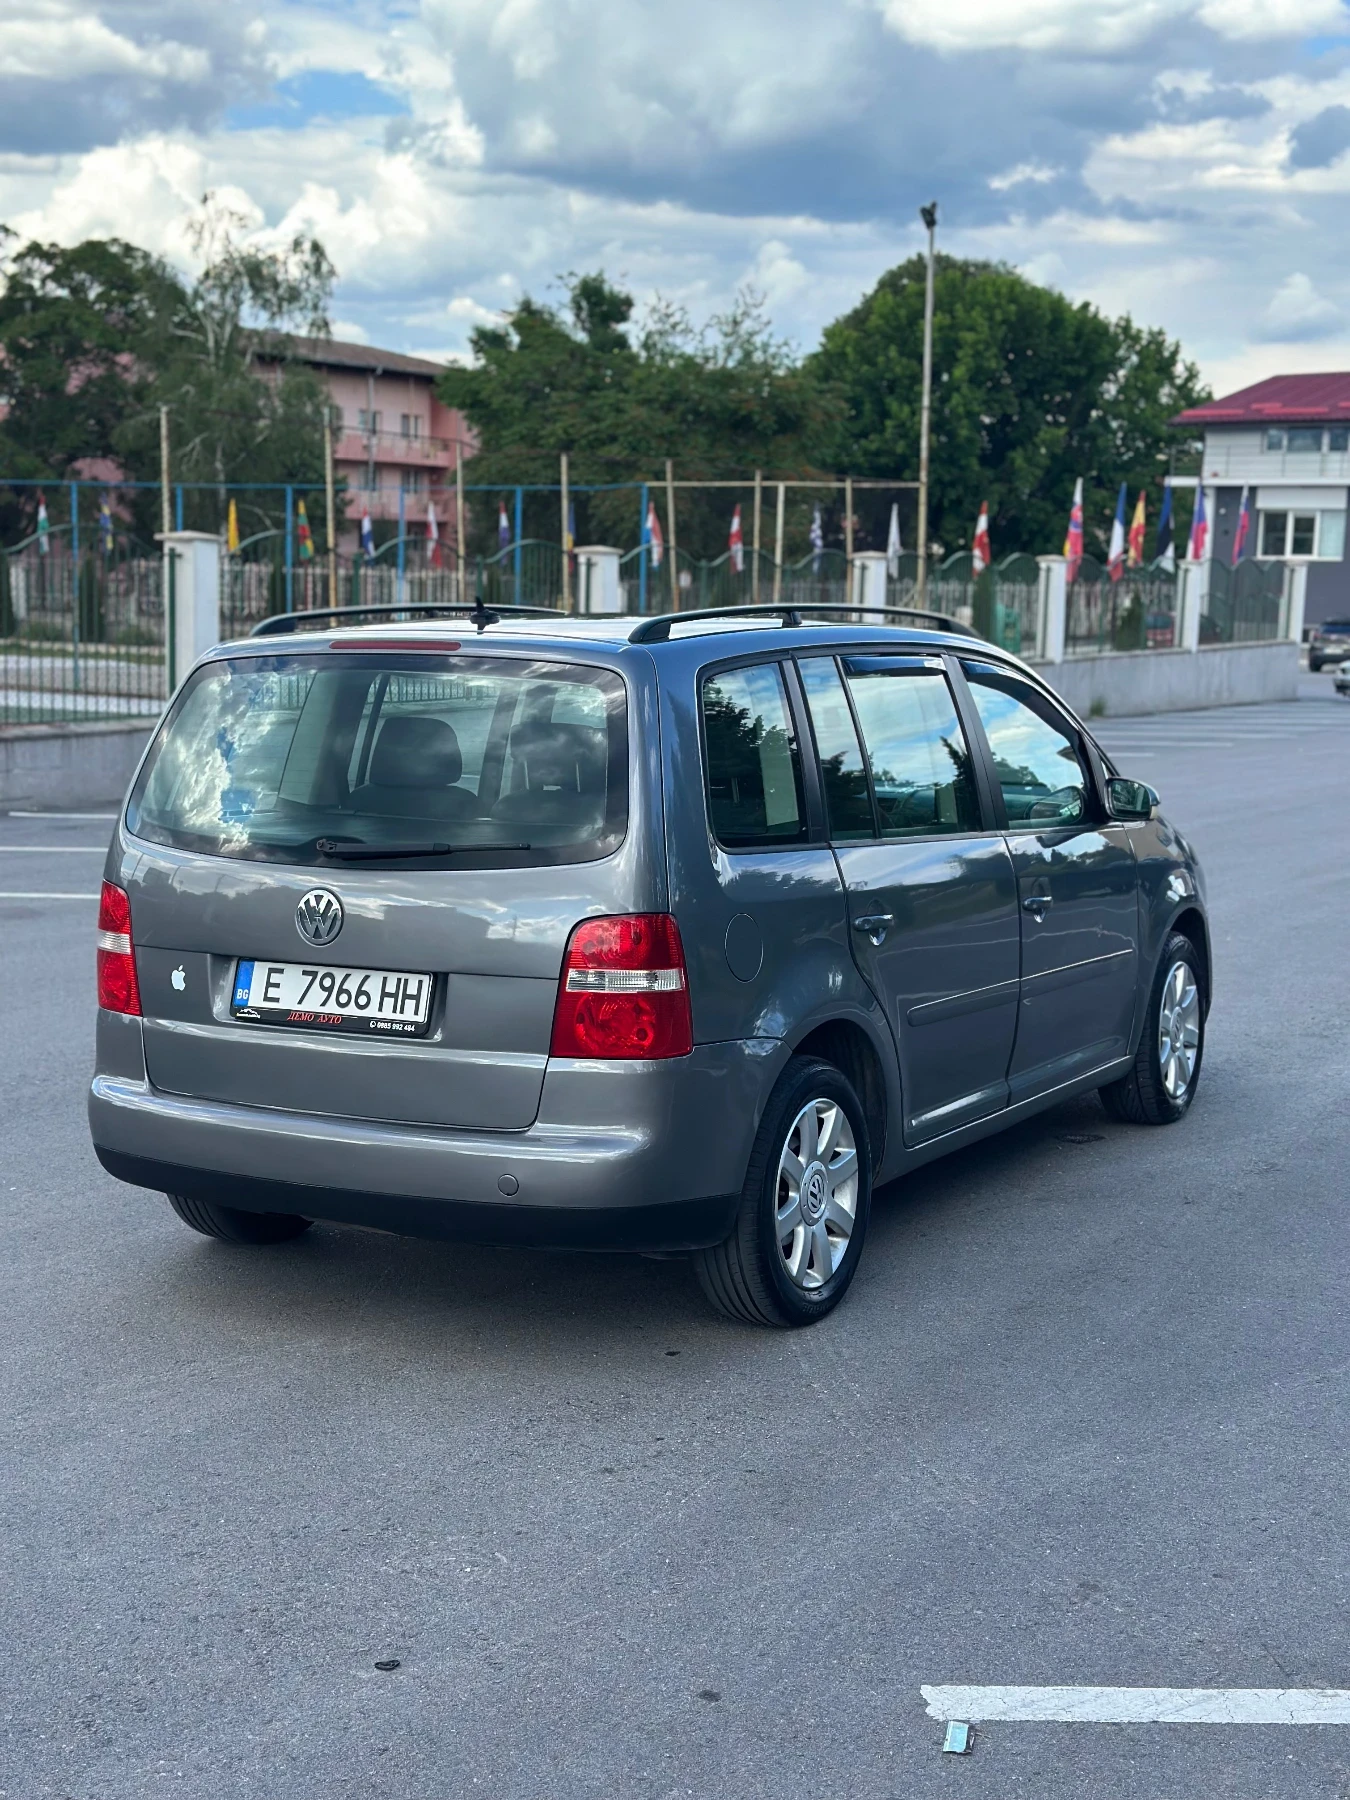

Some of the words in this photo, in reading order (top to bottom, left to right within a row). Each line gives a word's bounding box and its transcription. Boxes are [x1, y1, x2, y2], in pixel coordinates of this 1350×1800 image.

[237, 989, 249, 1000] BG
[263, 968, 285, 1003] E
[297, 970, 371, 1011] 7966
